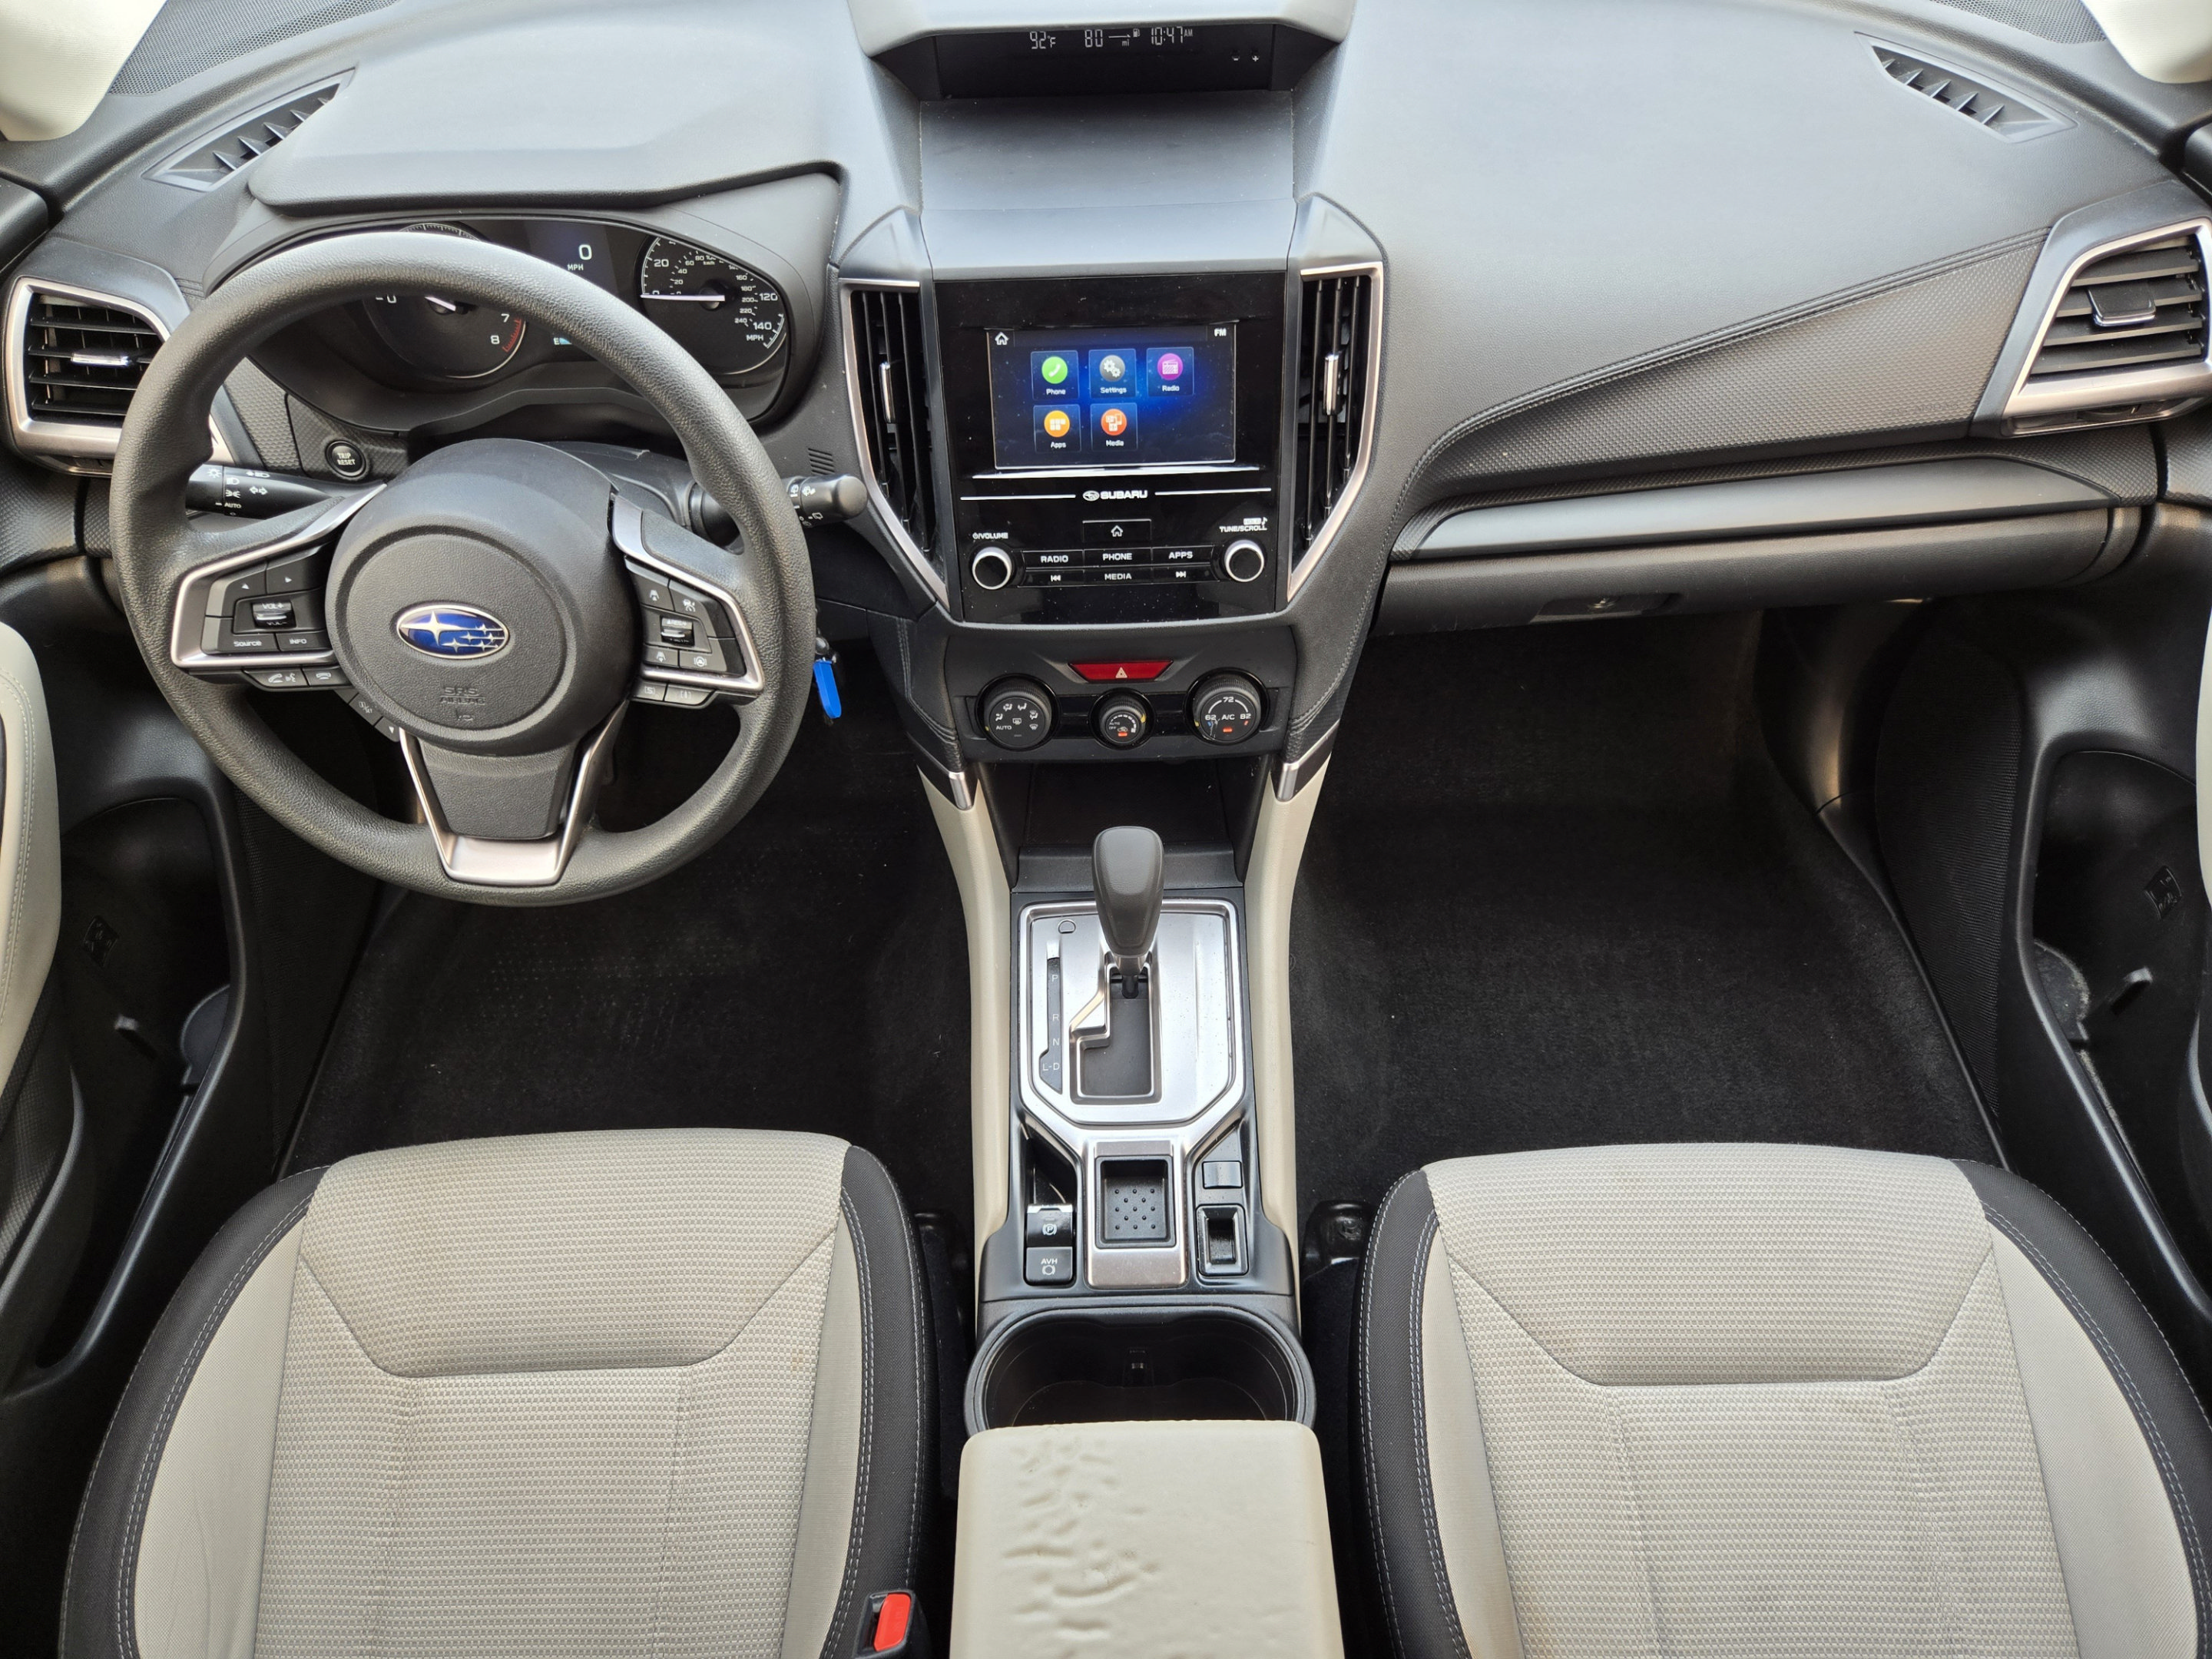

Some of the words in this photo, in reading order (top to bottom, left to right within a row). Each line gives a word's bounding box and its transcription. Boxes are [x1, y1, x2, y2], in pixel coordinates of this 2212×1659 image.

[1084, 29, 1103, 48] 80
[1151, 26, 1184, 45] 10:47
[578, 243, 592, 260] 0
[654, 258, 669, 267] 20
[759, 293, 778, 301] 120
[501, 313, 510, 323] 7
[753, 321, 773, 330] 140
[1214, 327, 1227, 337] FM
[490, 335, 500, 345] 8
[553, 337, 561, 346] E
[1100, 489, 1148, 499] SUBARU
[1040, 555, 1069, 563] RADIO
[1102, 552, 1133, 561] PHONE
[1168, 551, 1194, 559] APPS
[1051, 974, 1058, 982] P
[1052, 1013, 1060, 1022] R
[1052, 1038, 1060, 1046] N
